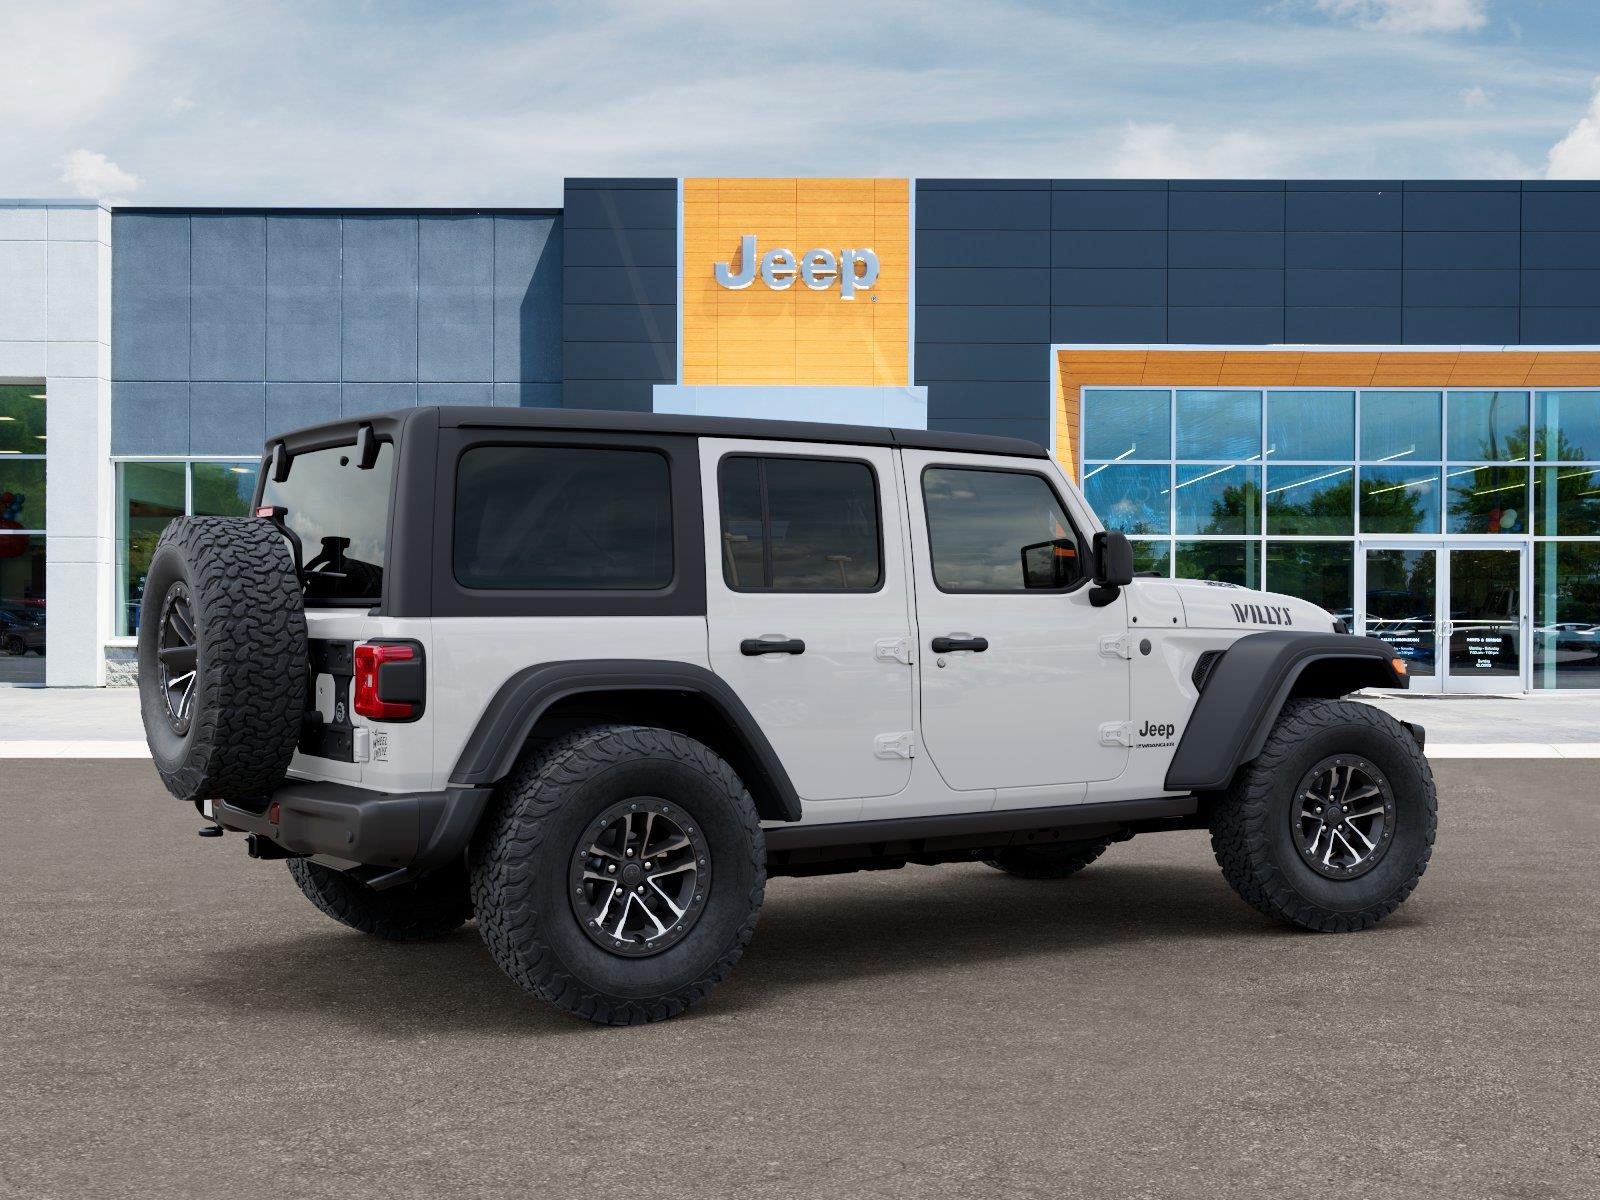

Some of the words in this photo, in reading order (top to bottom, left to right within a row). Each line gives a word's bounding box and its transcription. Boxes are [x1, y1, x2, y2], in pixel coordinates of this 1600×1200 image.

[714, 234, 880, 300] Jeep
[1231, 603, 1292, 626] WILLYS
[1138, 720, 1175, 740] Jeep
